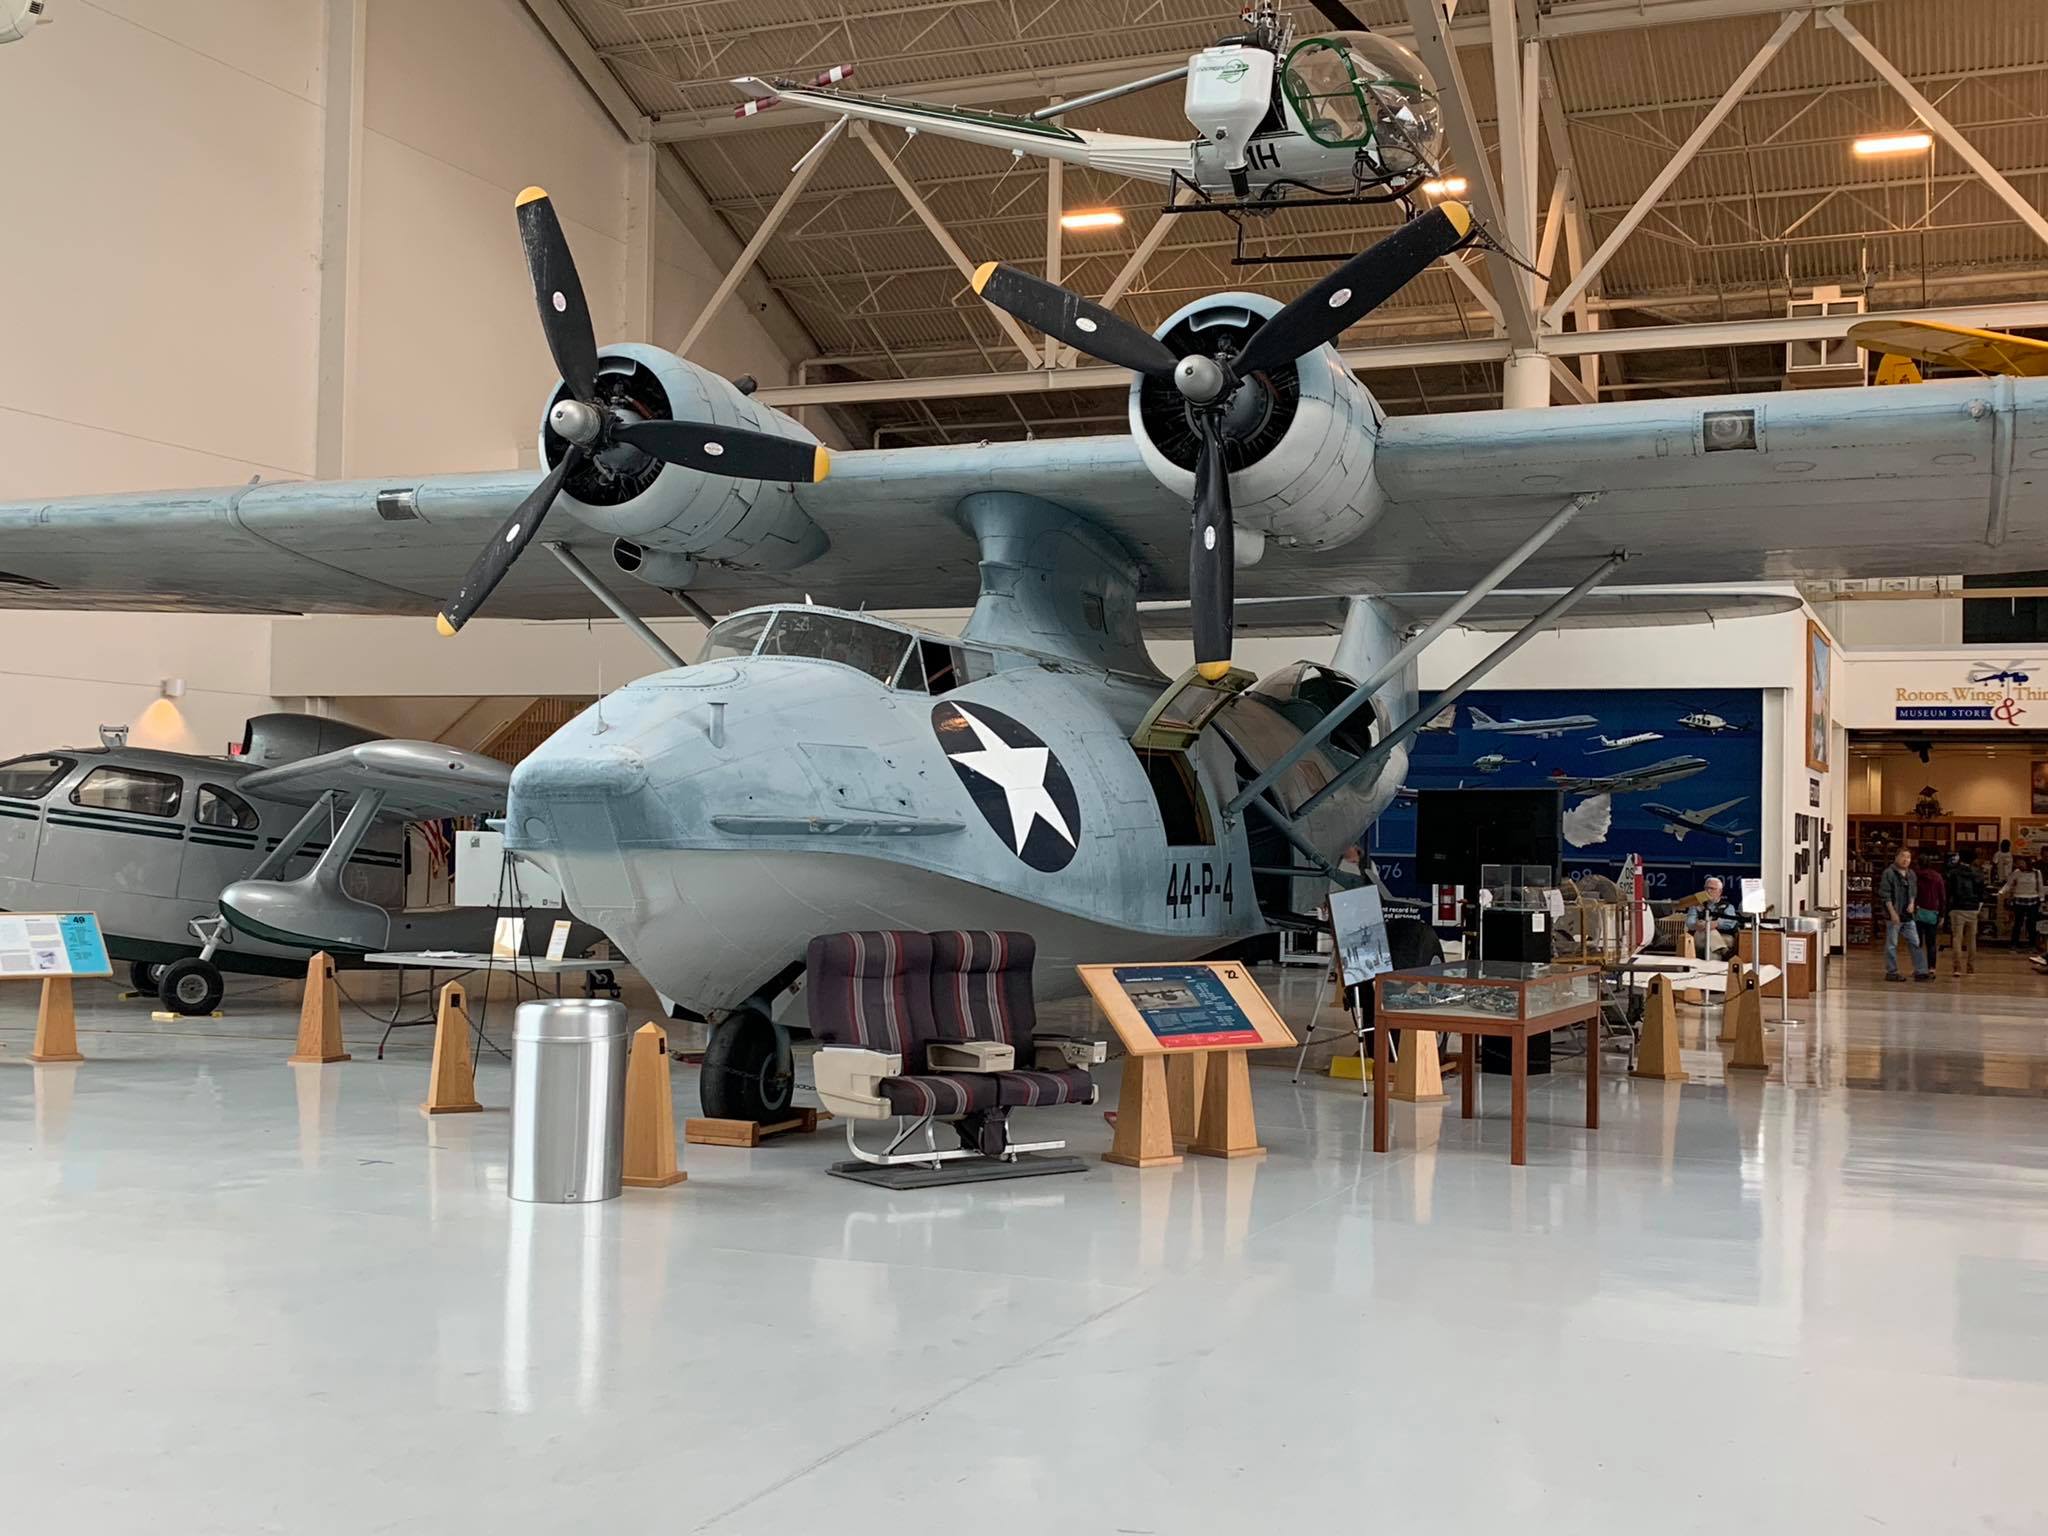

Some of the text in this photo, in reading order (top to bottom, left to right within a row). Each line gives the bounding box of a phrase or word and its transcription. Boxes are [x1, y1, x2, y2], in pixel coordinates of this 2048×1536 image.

[1246, 142, 1280, 170] 1H
[1952, 687, 2003, 704] Wings
[1900, 709, 1988, 717] MUSEUM STORE
[1995, 698, 2026, 726] &
